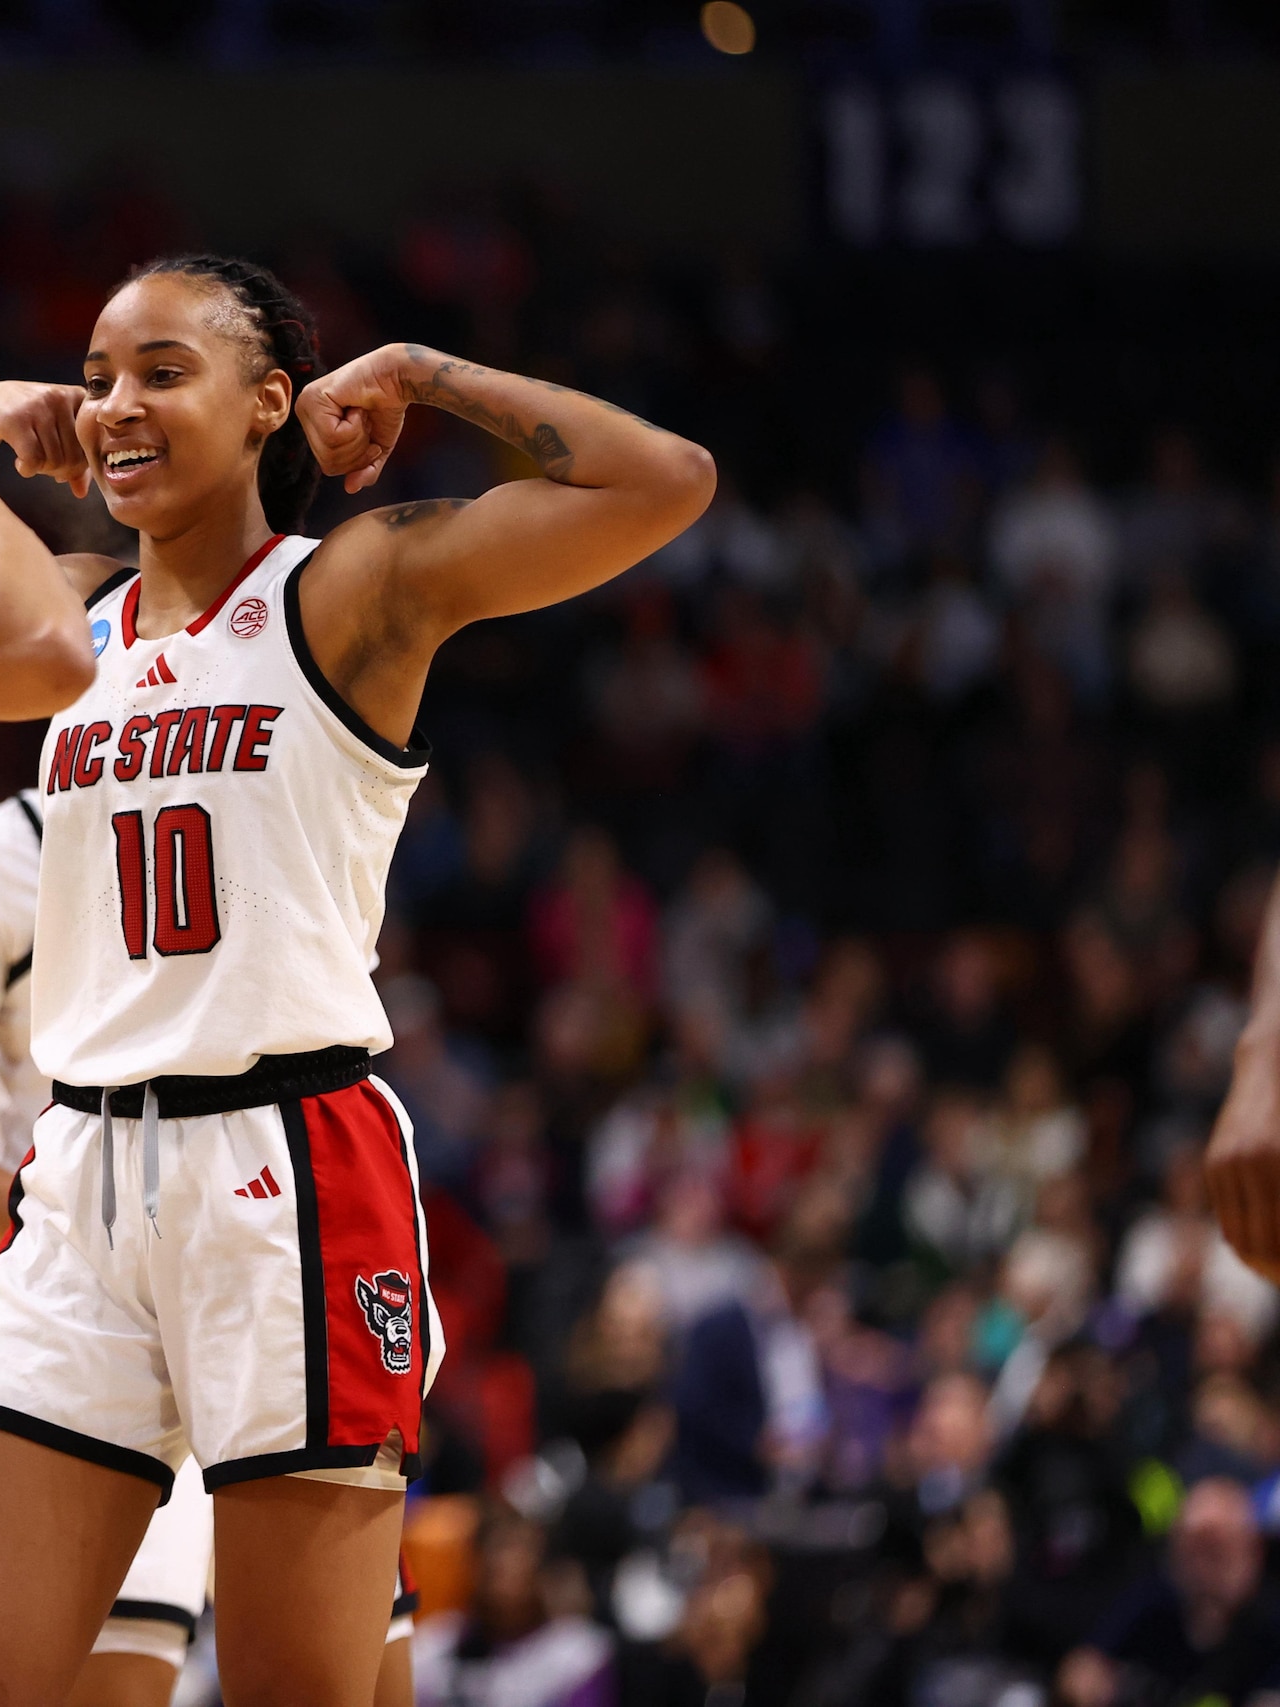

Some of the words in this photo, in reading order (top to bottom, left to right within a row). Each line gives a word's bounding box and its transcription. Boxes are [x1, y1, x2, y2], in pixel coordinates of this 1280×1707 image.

[235, 610, 266, 621] ACC
[47, 720, 113, 796] NC
[113, 704, 285, 781] STATE
[112, 803, 221, 960] 10
[382, 1288, 391, 1300] NC
